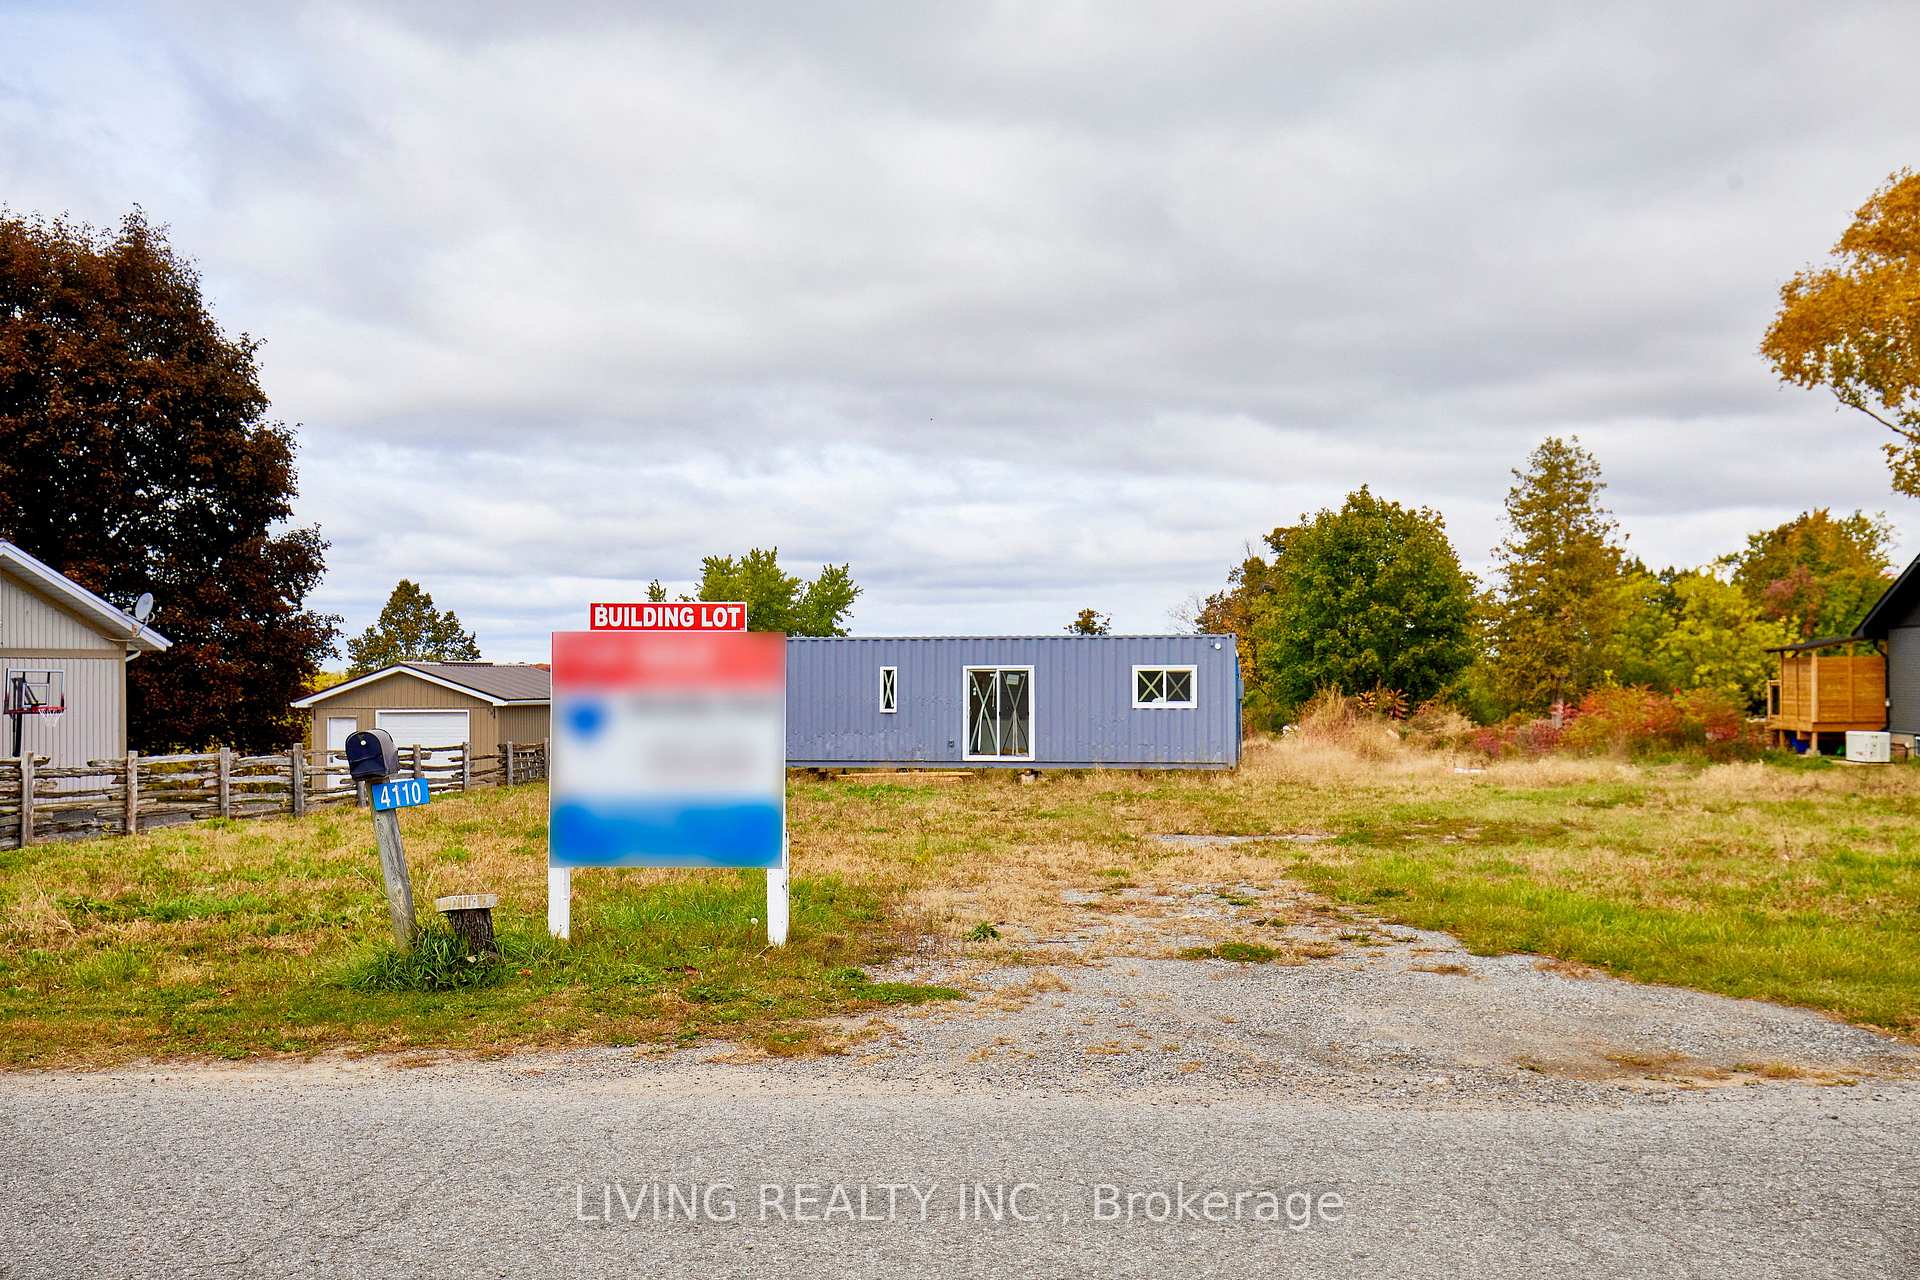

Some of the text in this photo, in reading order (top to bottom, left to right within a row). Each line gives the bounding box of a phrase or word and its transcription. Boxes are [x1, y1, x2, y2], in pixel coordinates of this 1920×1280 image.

[594, 606, 740, 628] BUILDING LOT
[380, 781, 421, 808] 4110
